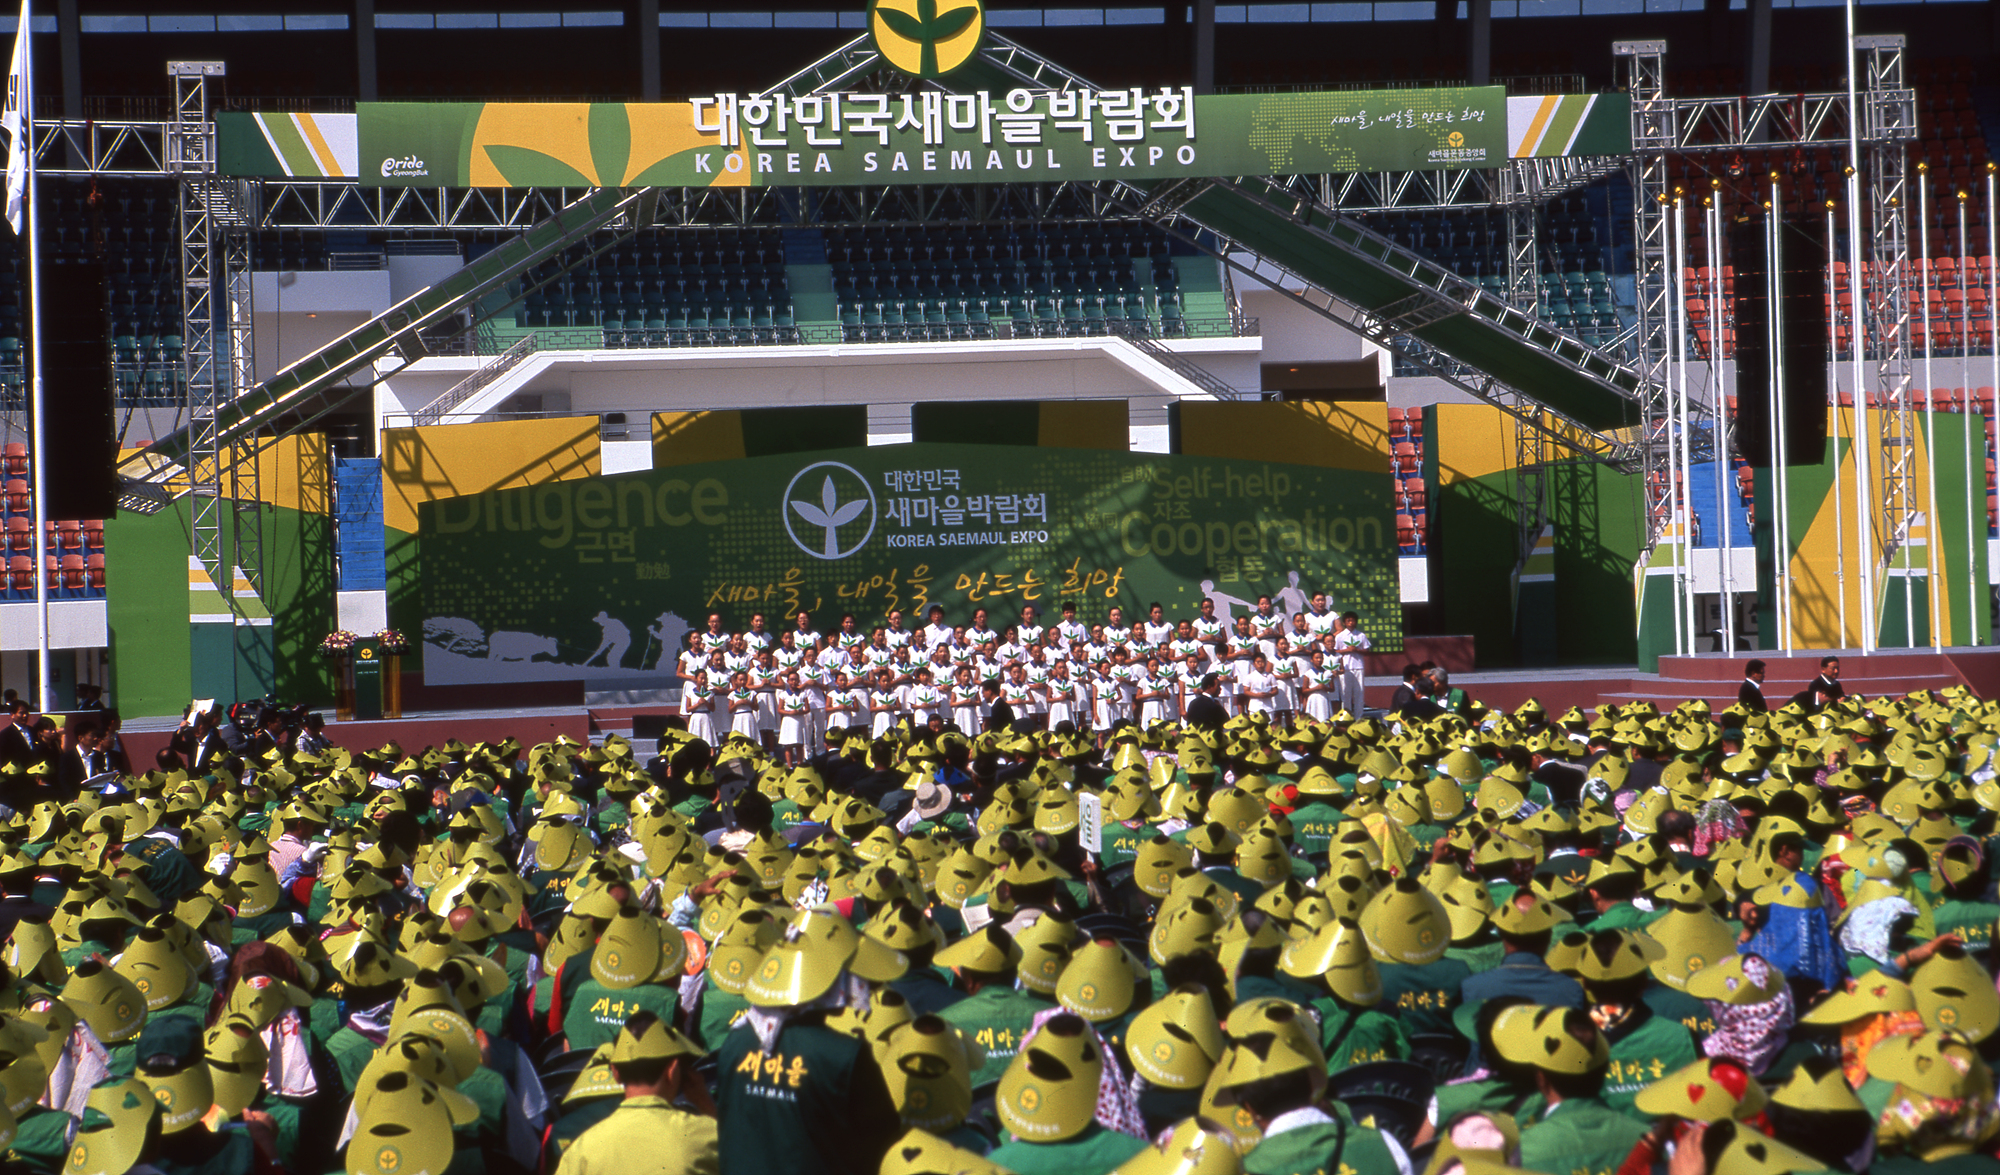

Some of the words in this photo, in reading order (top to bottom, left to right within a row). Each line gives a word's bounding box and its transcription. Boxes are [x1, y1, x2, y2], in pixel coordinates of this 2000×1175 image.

[690, 86, 1195, 146] 대한민국새마을박람회
[1331, 109, 1374, 130] 새마을,
[1378, 108, 1418, 129] 내일을
[1421, 110, 1456, 123] 만드는
[1460, 106, 1486, 122] 희망
[695, 151, 831, 174] KOREA
[864, 148, 1061, 172] SAEMAUL
[1092, 145, 1196, 168] EXPO
[883, 469, 961, 492] 대한민국
[1152, 465, 1292, 505] Self-help
[884, 492, 1047, 527] 새마을박람회
[1152, 500, 1192, 521] 자조
[574, 530, 637, 563] 근면
[886, 534, 936, 547] KOREA
[938, 531, 1007, 546] SAEMAUL
[1010, 529, 1049, 544] EXPO
[1120, 507, 1383, 567] Cooperation
[1215, 556, 1266, 583] 협동
[705, 566, 823, 620] 새마을,
[837, 563, 934, 617] 내일을
[955, 568, 1046, 602] 만드는
[1060, 556, 1126, 598] 희망
[736, 1049, 809, 1088] 새마을
